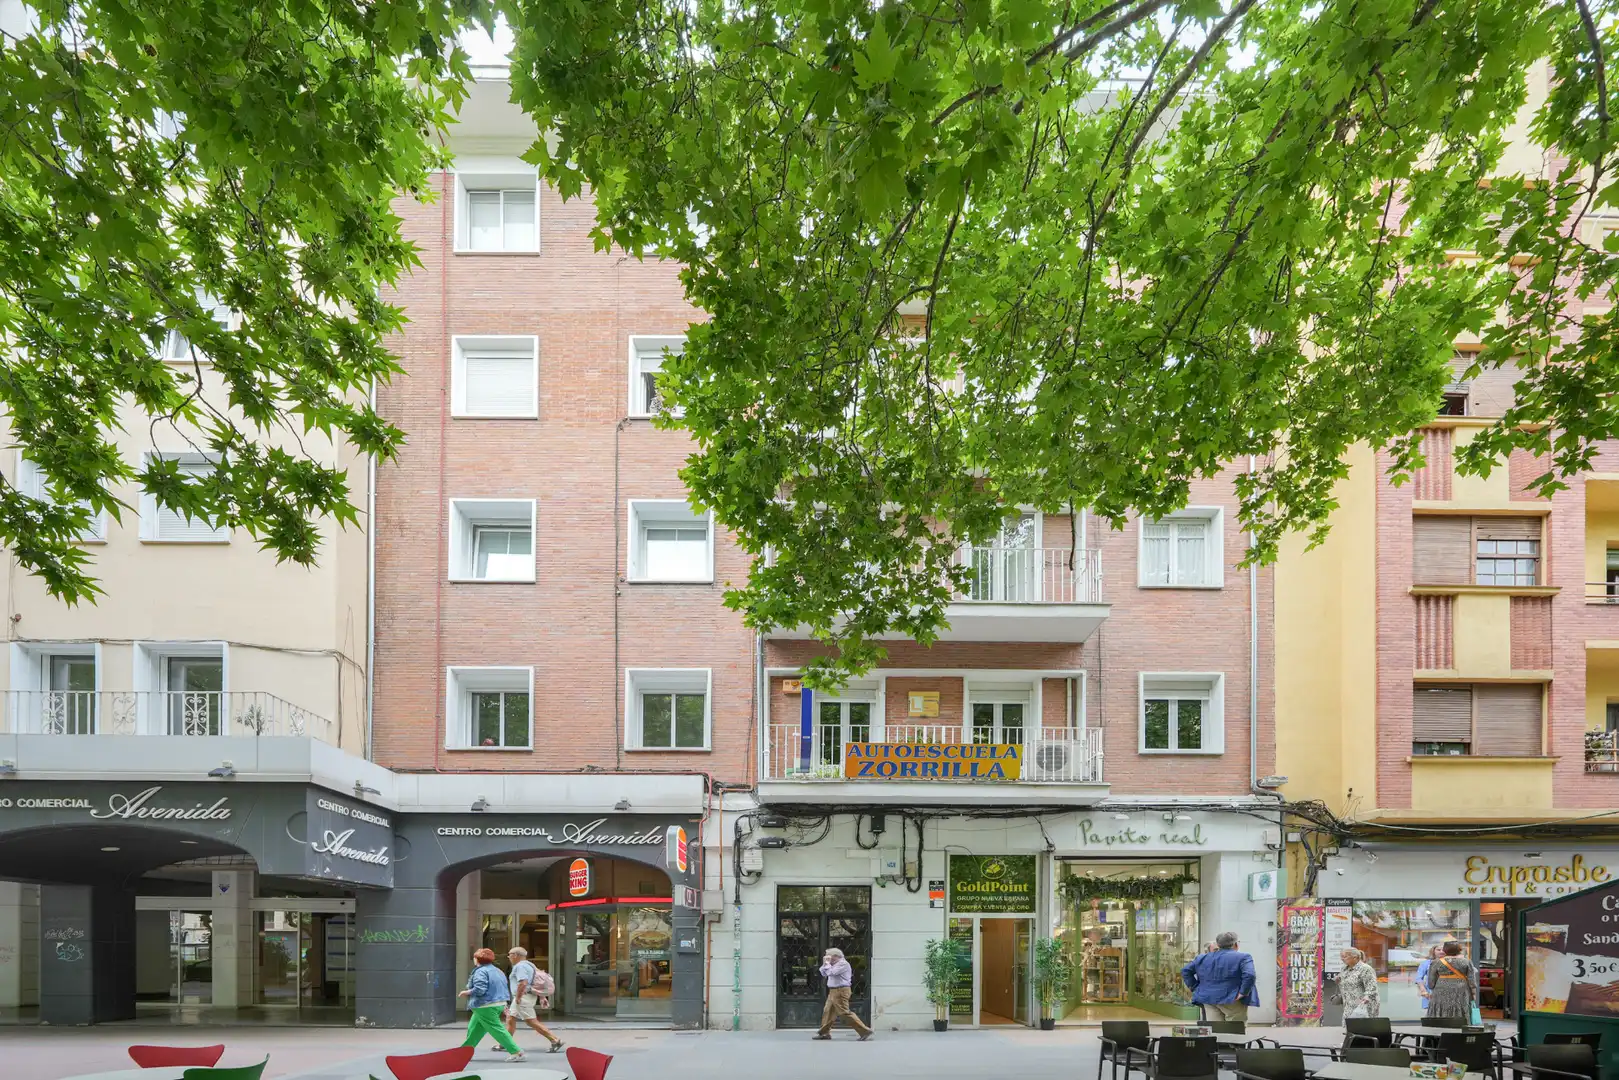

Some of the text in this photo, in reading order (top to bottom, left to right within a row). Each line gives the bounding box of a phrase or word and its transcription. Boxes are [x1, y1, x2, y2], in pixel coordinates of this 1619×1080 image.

[847, 744, 1018, 759] AUTOESCUELA
[857, 760, 1005, 778] ZORRILLA
[0, 786, 231, 819] O COMERCIAL Avenida
[317, 799, 390, 828] CENTRO COMERCIAL
[437, 818, 663, 845] CENTRO COMERCIAL Avenida
[1079, 819, 1208, 846] Pavito real
[311, 828, 390, 866] Avenida
[570, 869, 587, 879] BURGER
[570, 877, 587, 889] KING
[956, 881, 1029, 893] GoldPoint
[1458, 887, 1506, 895] SWEET
[1524, 882, 1537, 894] &
[1290, 915, 1317, 928] GRAN
[1290, 953, 1315, 967] INTE
[1291, 967, 1314, 981] GRA
[1292, 981, 1313, 995] LES
